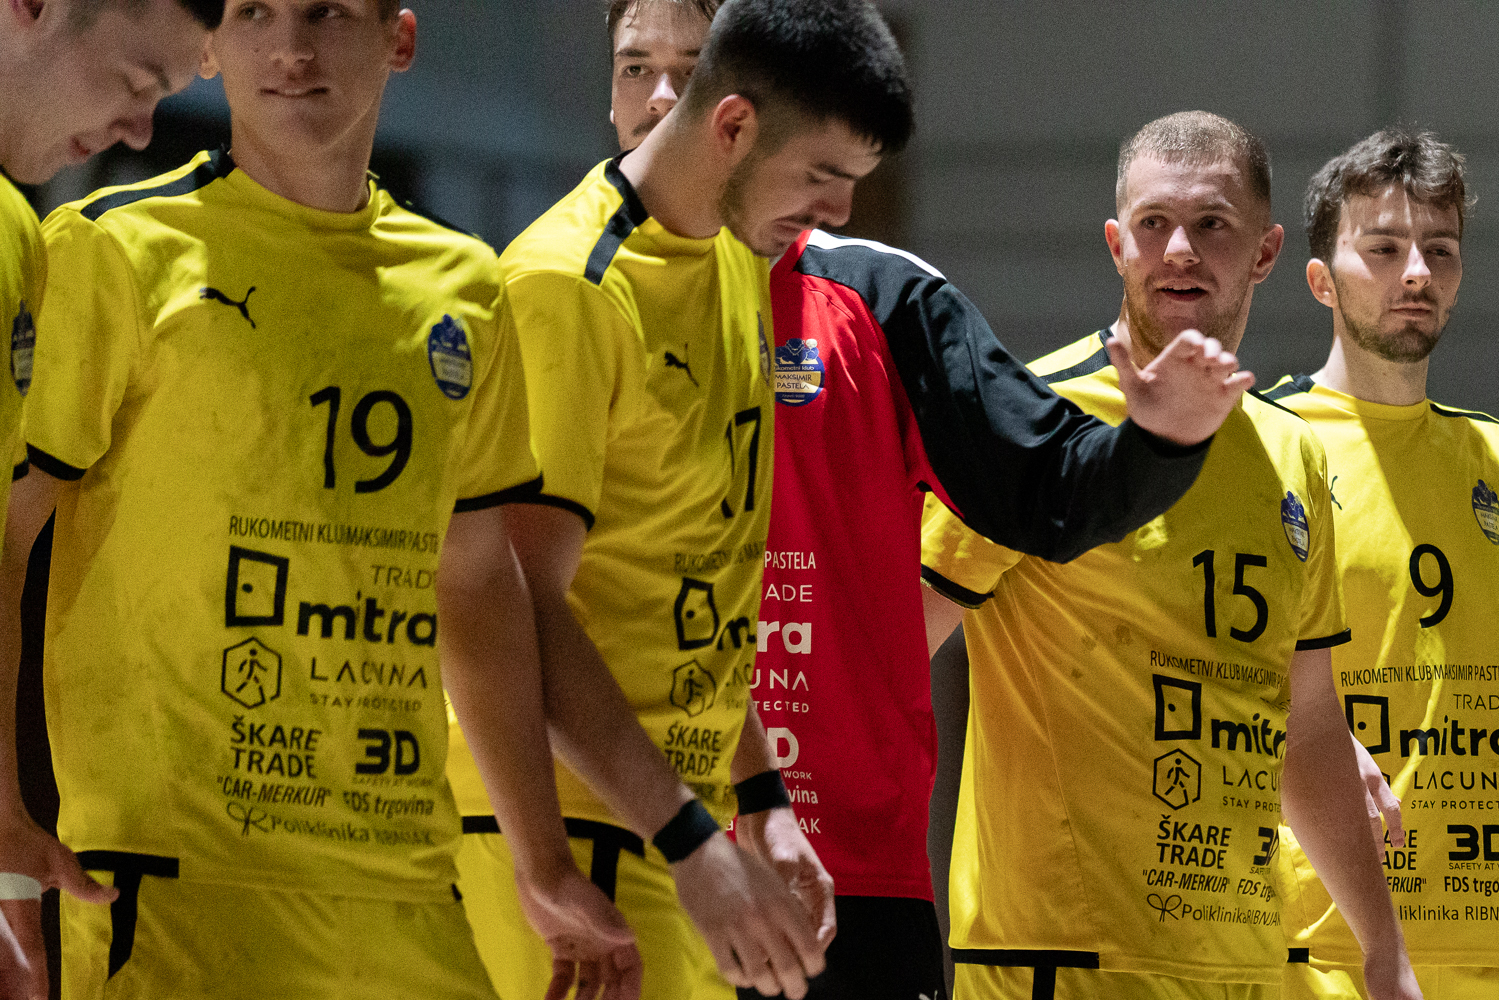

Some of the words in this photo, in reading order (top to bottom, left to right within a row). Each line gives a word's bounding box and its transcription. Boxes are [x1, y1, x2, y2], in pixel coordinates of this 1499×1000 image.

[309, 385, 413, 494] 19
[229, 515, 314, 544] RUKOMETNI
[764, 550, 817, 570] PASTELA
[371, 564, 436, 589] TRAD
[1409, 543, 1454, 629] 9
[764, 583, 813, 602] ADE
[1192, 549, 1269, 643] 15
[1150, 650, 1213, 677] RUKOMETNI
[1216, 662, 1240, 681] KLUB
[1340, 666, 1403, 688] RUKOMETNI
[1406, 664, 1433, 682] KLUB
[754, 700, 810, 713] TECTED
[231, 714, 322, 751] ŠKARE
[1211, 712, 1287, 760] mitr
[230, 746, 318, 779] TRADE
[355, 728, 420, 775] 3D
[783, 769, 812, 781] WORK
[1223, 765, 1278, 792] LACU
[1223, 795, 1250, 810] STAY
[1411, 799, 1436, 810] STAY
[1157, 814, 1232, 847] ŠKARE
[1156, 842, 1228, 870] TRADE
[1382, 851, 1417, 871] ADE
[1448, 862, 1482, 871] SAFETY
[1484, 862, 1496, 871] AT
[1237, 878, 1262, 896] FDS
[1444, 876, 1470, 893] FDS
[1181, 903, 1247, 924] Poliklinika
[1399, 905, 1459, 921] liklinika
